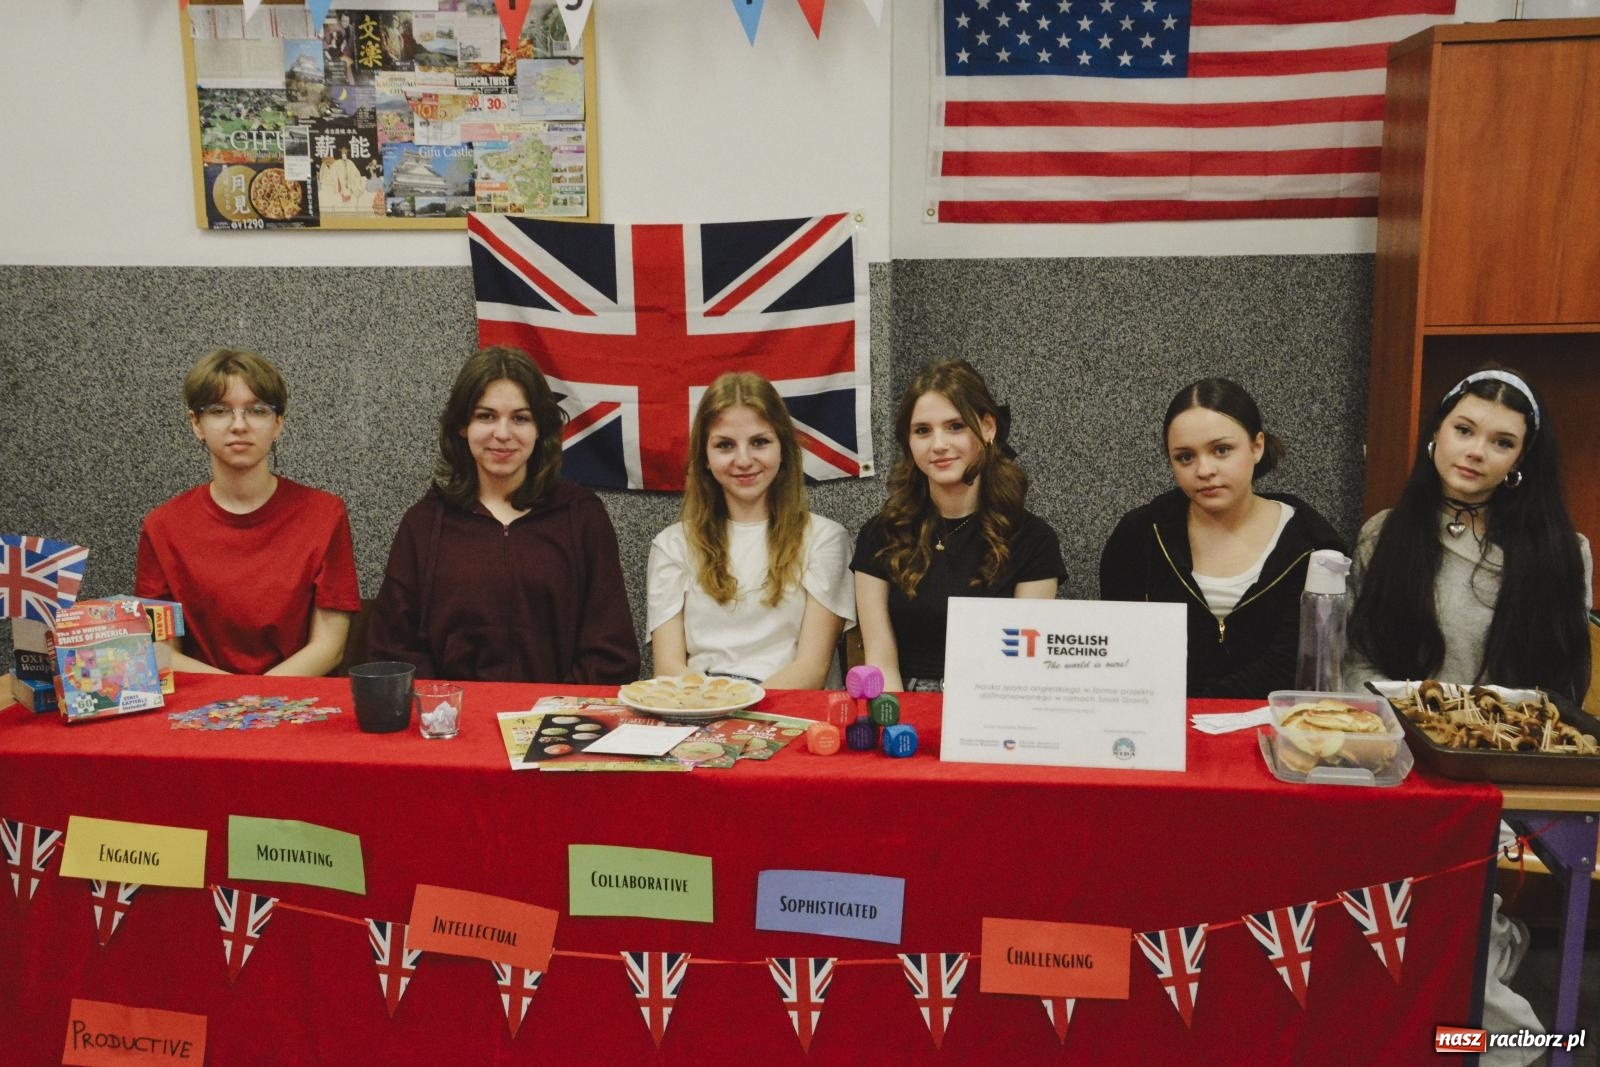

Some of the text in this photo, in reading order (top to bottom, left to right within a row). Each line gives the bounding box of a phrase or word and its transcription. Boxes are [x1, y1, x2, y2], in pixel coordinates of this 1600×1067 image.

[456, 76, 510, 87] TROPICAL TWIST
[418, 146, 474, 159] Gifu Castle
[58, 628, 129, 645] STATES OF AMERICA
[1047, 634, 1109, 646] ENGLISH
[1047, 646, 1108, 657] TEACHING
[1043, 660, 1060, 669] The
[1064, 660, 1090, 669] world
[99, 843, 160, 867] ENGAGING
[256, 844, 333, 868] MOTIVATING
[591, 870, 689, 893] COLLABORATIVE
[780, 895, 878, 920] SOPHISTICATED
[432, 915, 517, 947] INTELLECTUAL
[1006, 946, 1094, 969] CHALLENGING
[72, 1020, 193, 1058] PRODUCTIVE
